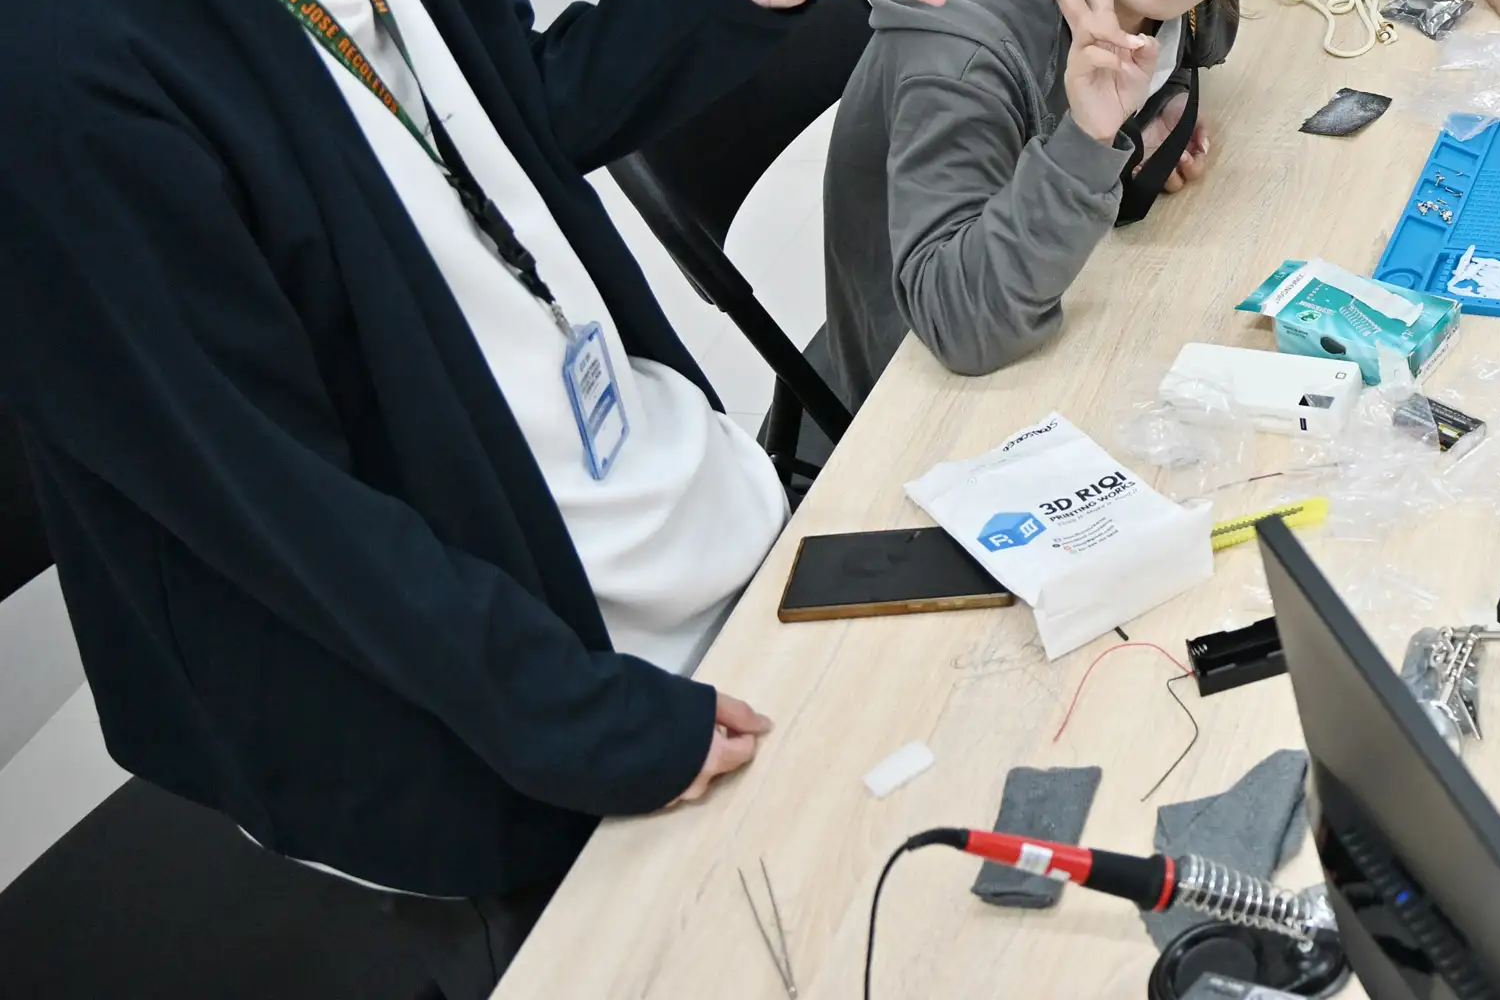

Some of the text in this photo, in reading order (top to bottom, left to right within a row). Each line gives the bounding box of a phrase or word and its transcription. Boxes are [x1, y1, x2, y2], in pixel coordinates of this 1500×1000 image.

[301, 2, 339, 39] JOSE
[1038, 471, 1127, 516] 3D RIQI
[1049, 481, 1136, 522] PRINTING WORKS
